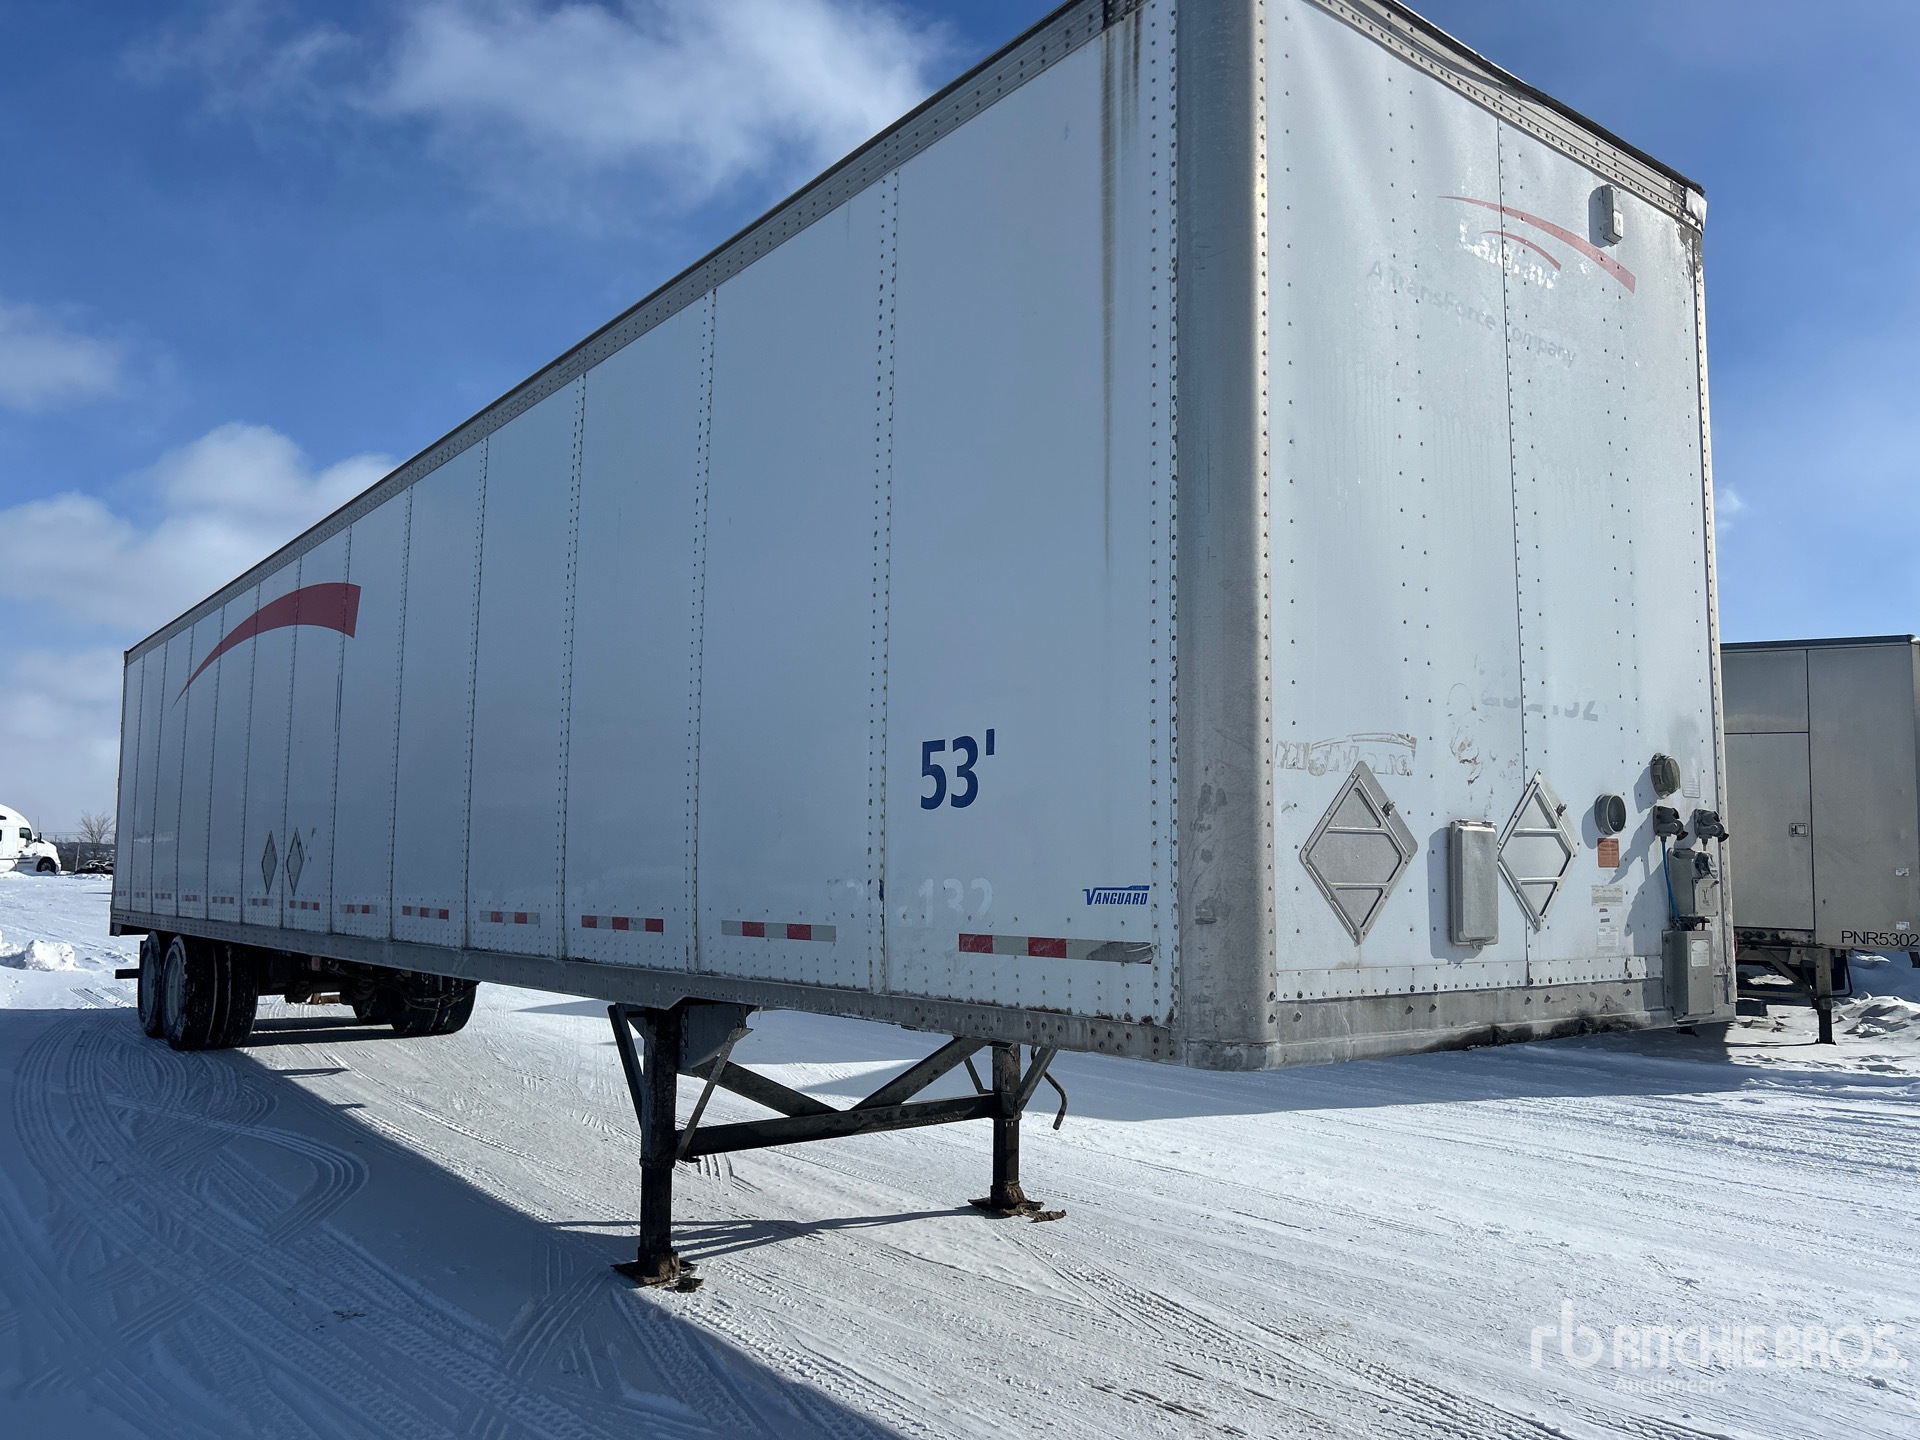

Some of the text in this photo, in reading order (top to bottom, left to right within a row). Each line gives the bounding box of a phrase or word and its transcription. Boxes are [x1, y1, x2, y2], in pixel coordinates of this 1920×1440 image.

[920, 728, 995, 810] 53'
[1082, 885, 1150, 905] VANGUARD
[1841, 930, 1920, 948] PNR5302
